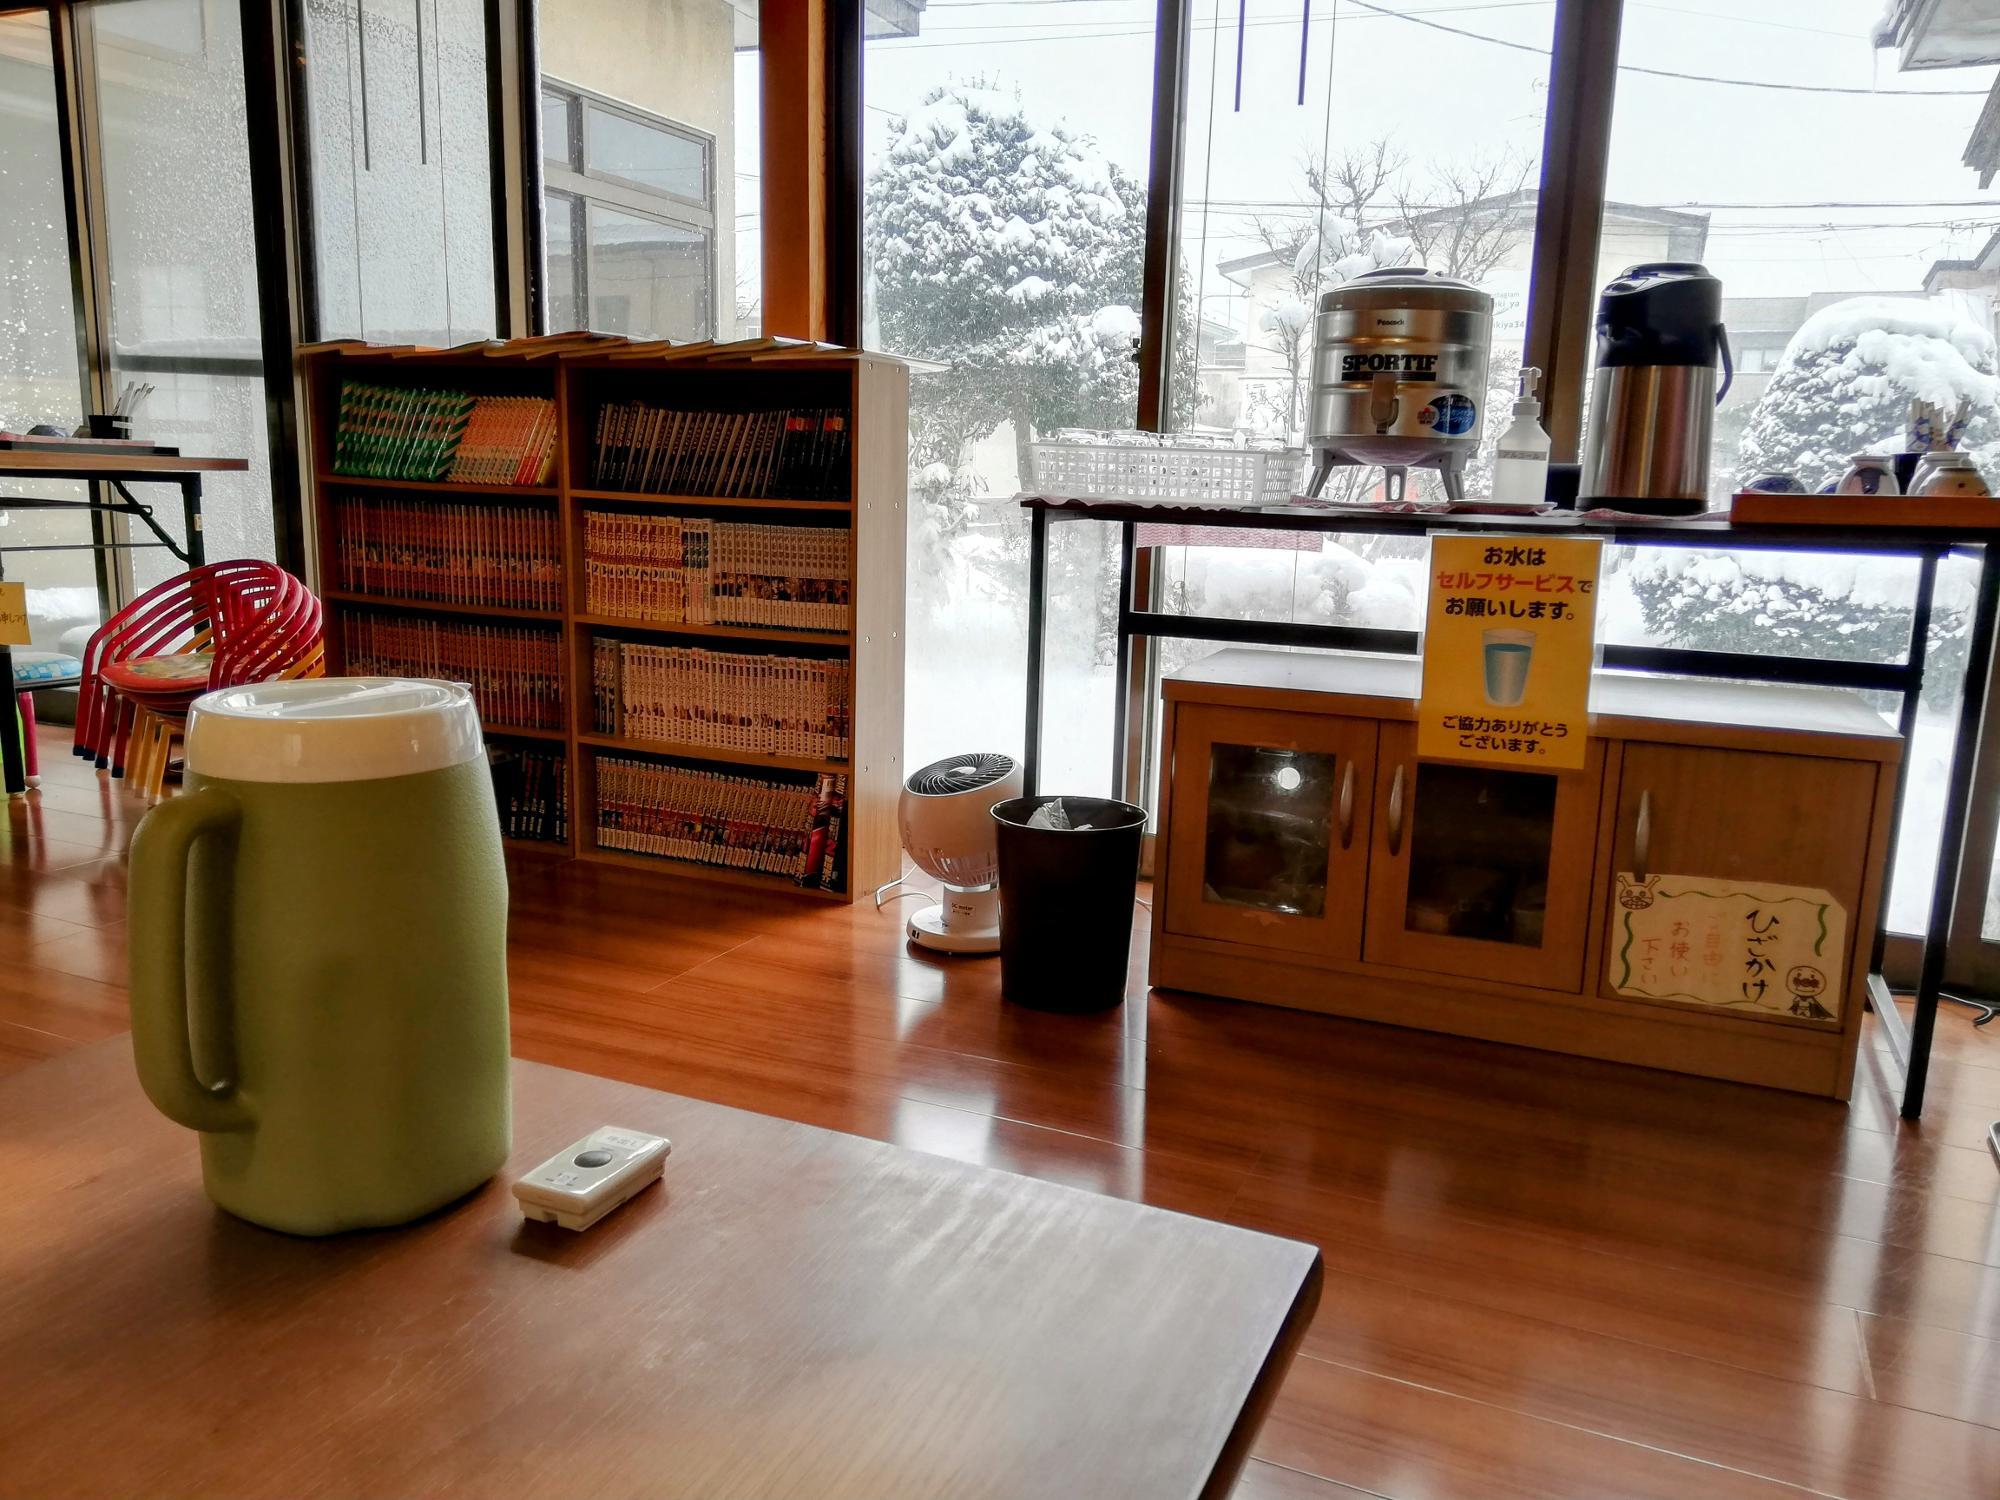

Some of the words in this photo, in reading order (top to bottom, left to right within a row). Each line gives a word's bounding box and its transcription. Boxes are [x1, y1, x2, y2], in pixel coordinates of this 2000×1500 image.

[1342, 354, 1438, 371] SPORTIF
[1484, 546, 1546, 566] お水は
[1436, 571, 1593, 593] セルフサービスで
[1445, 597, 1574, 621] お願いします。
[1442, 715, 1568, 737] ご協力ありがとう
[1458, 734, 1546, 755] ございます。
[1669, 921, 1690, 977] お使い
[1742, 909, 1780, 1004] ひざかけ
[1640, 937, 1662, 985] 下さい
